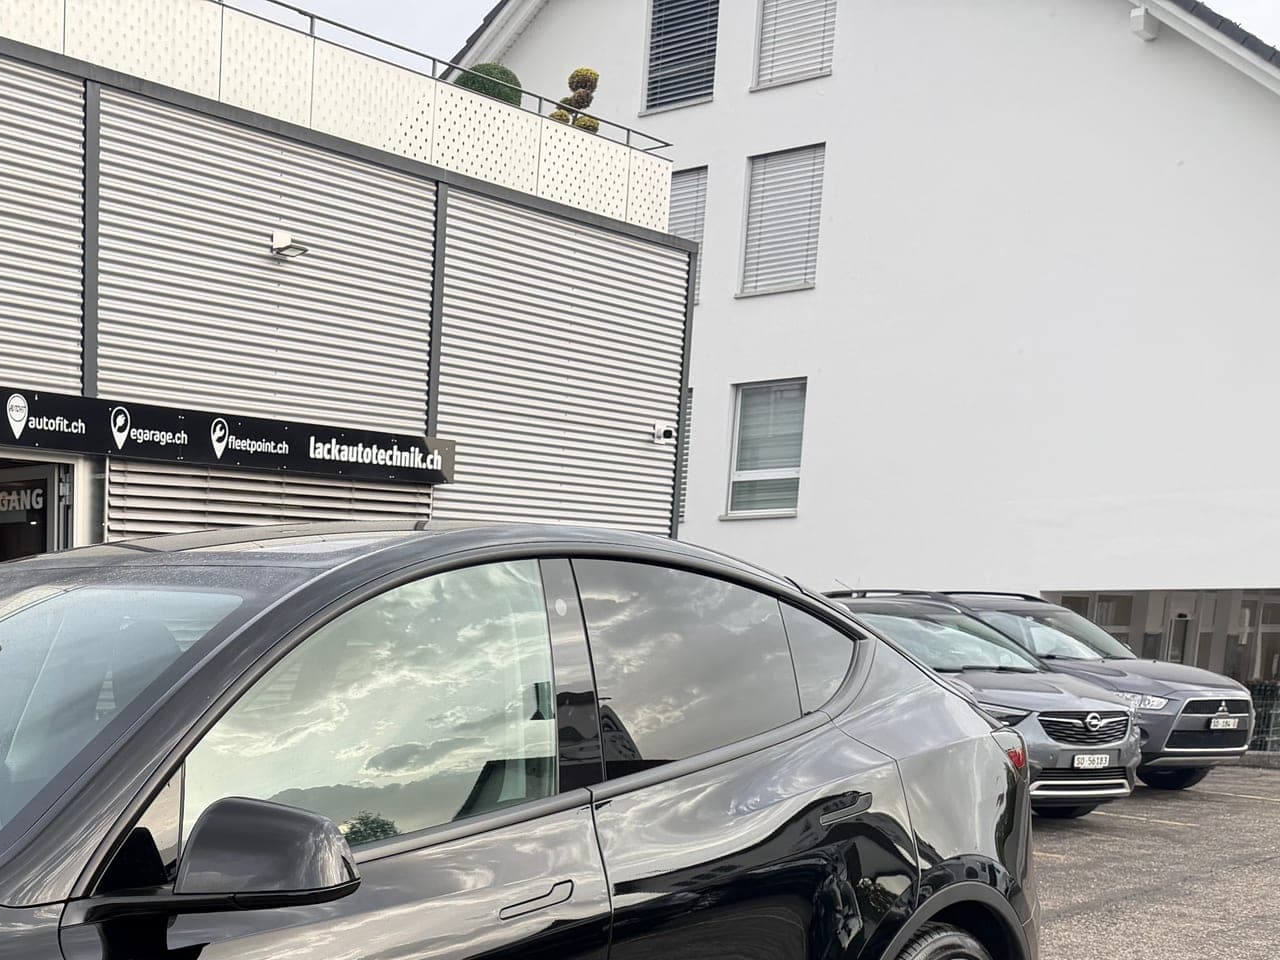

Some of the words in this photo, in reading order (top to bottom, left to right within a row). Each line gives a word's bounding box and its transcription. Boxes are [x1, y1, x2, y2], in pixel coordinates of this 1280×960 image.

[28, 416, 86, 435] autofit.ch
[130, 428, 188, 445] egarage.ch
[228, 435, 289, 455] fleetpoint.ch
[309, 436, 442, 471] lackautotechnik.ch
